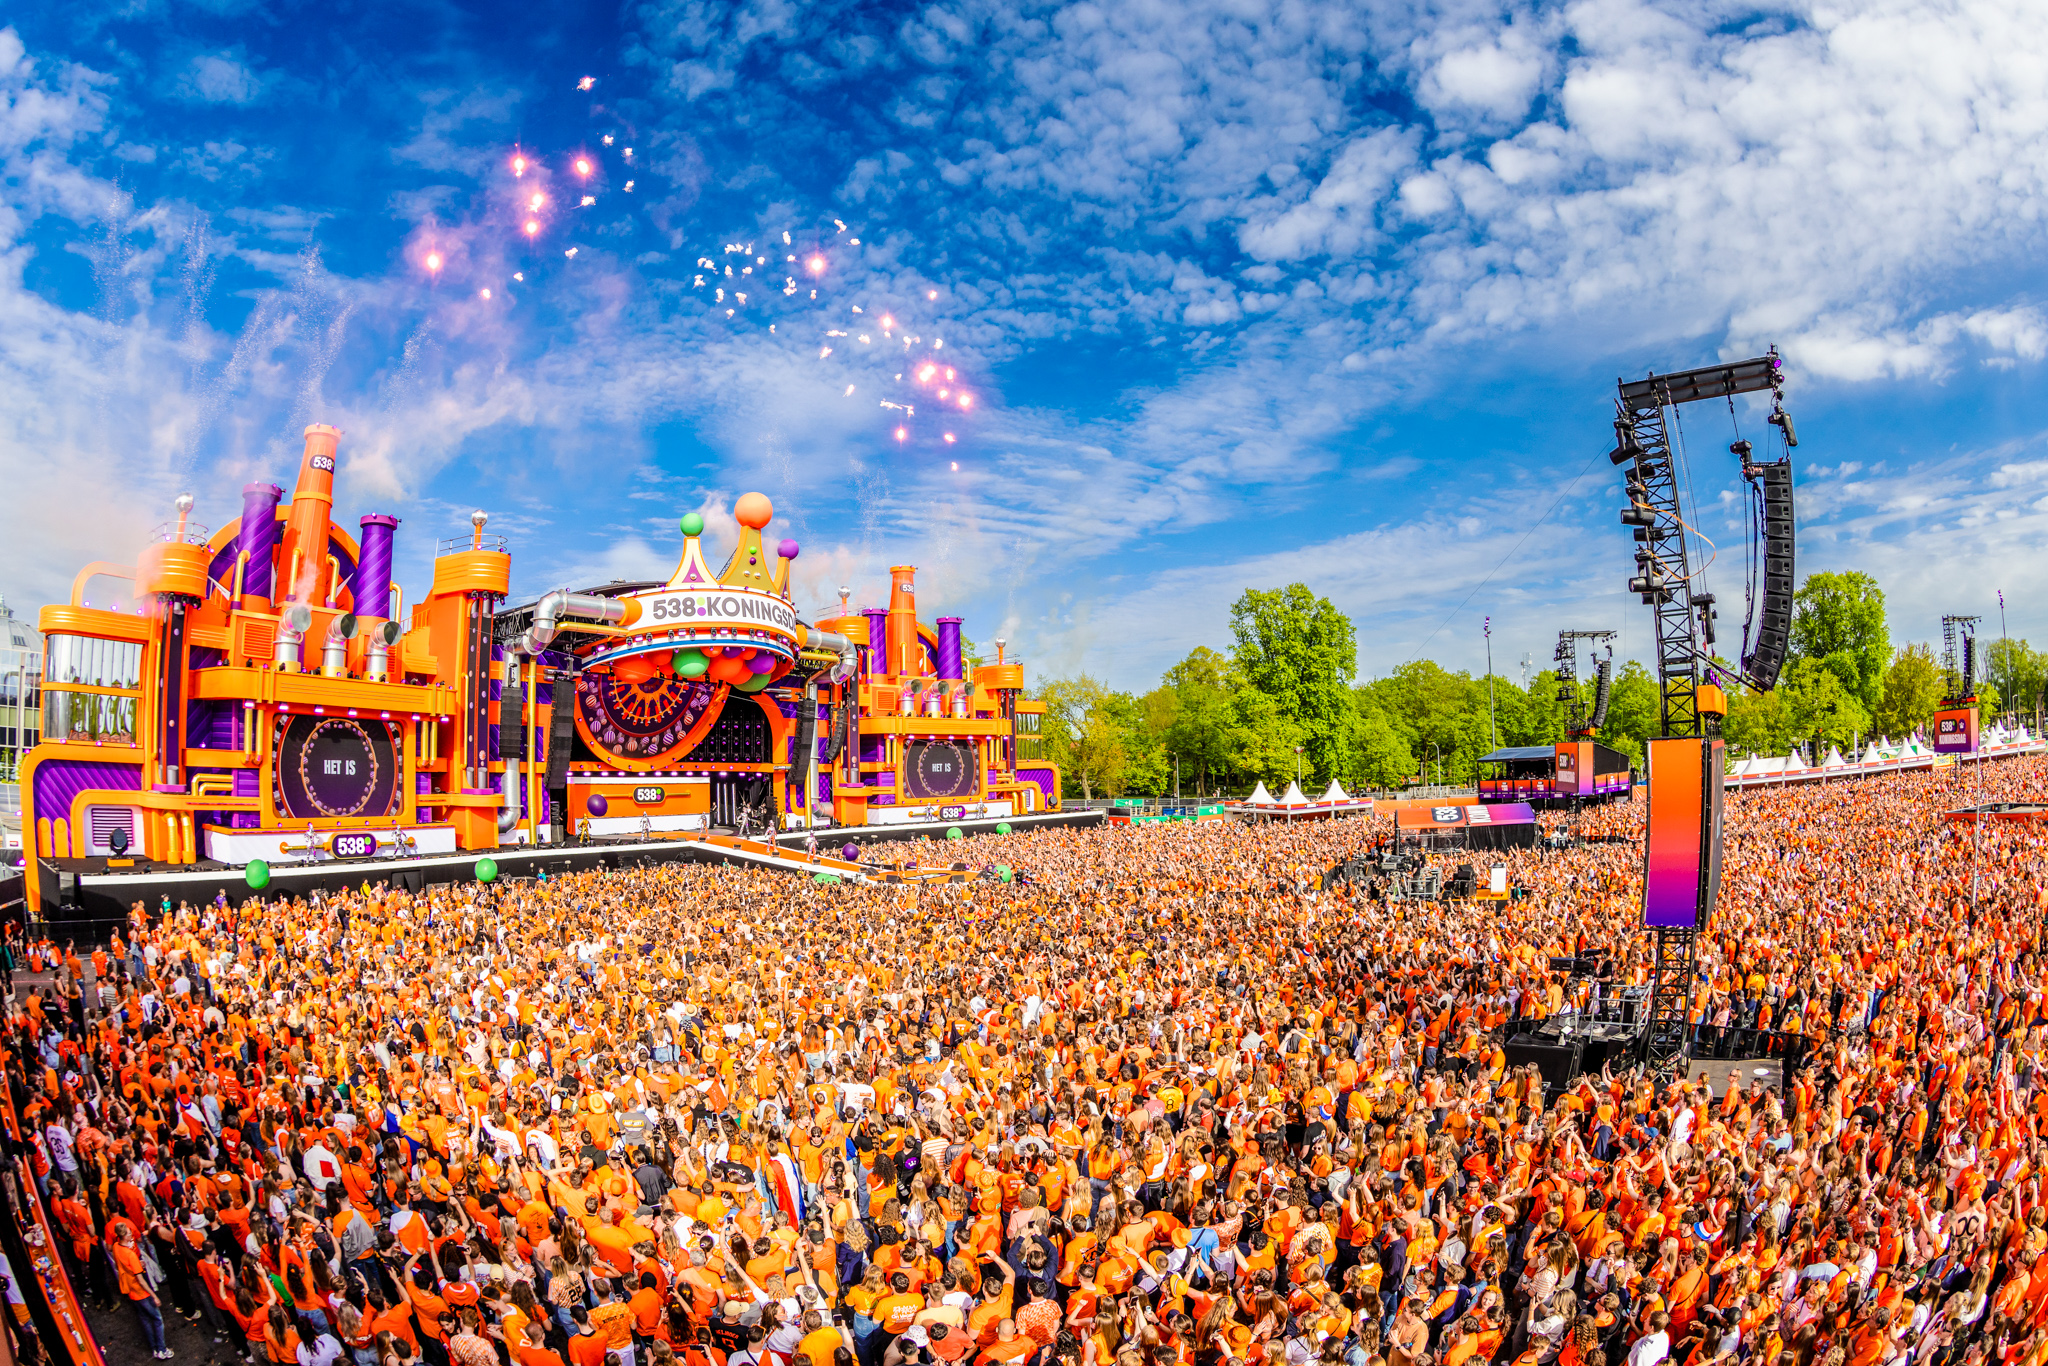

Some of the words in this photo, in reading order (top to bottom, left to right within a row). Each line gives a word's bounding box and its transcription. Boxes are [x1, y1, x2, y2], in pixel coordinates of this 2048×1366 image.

[313, 456, 333, 470] 538
[653, 597, 696, 620] 538
[1941, 721, 1953, 732] 538
[323, 759, 342, 775] HET
[345, 759, 356, 776] IS
[931, 763, 943, 773] HET
[944, 762, 952, 773] IS
[637, 788, 657, 801] 538
[942, 807, 959, 819] 538
[337, 836, 366, 855] 538
[1166, 1098, 1174, 1111] 8
